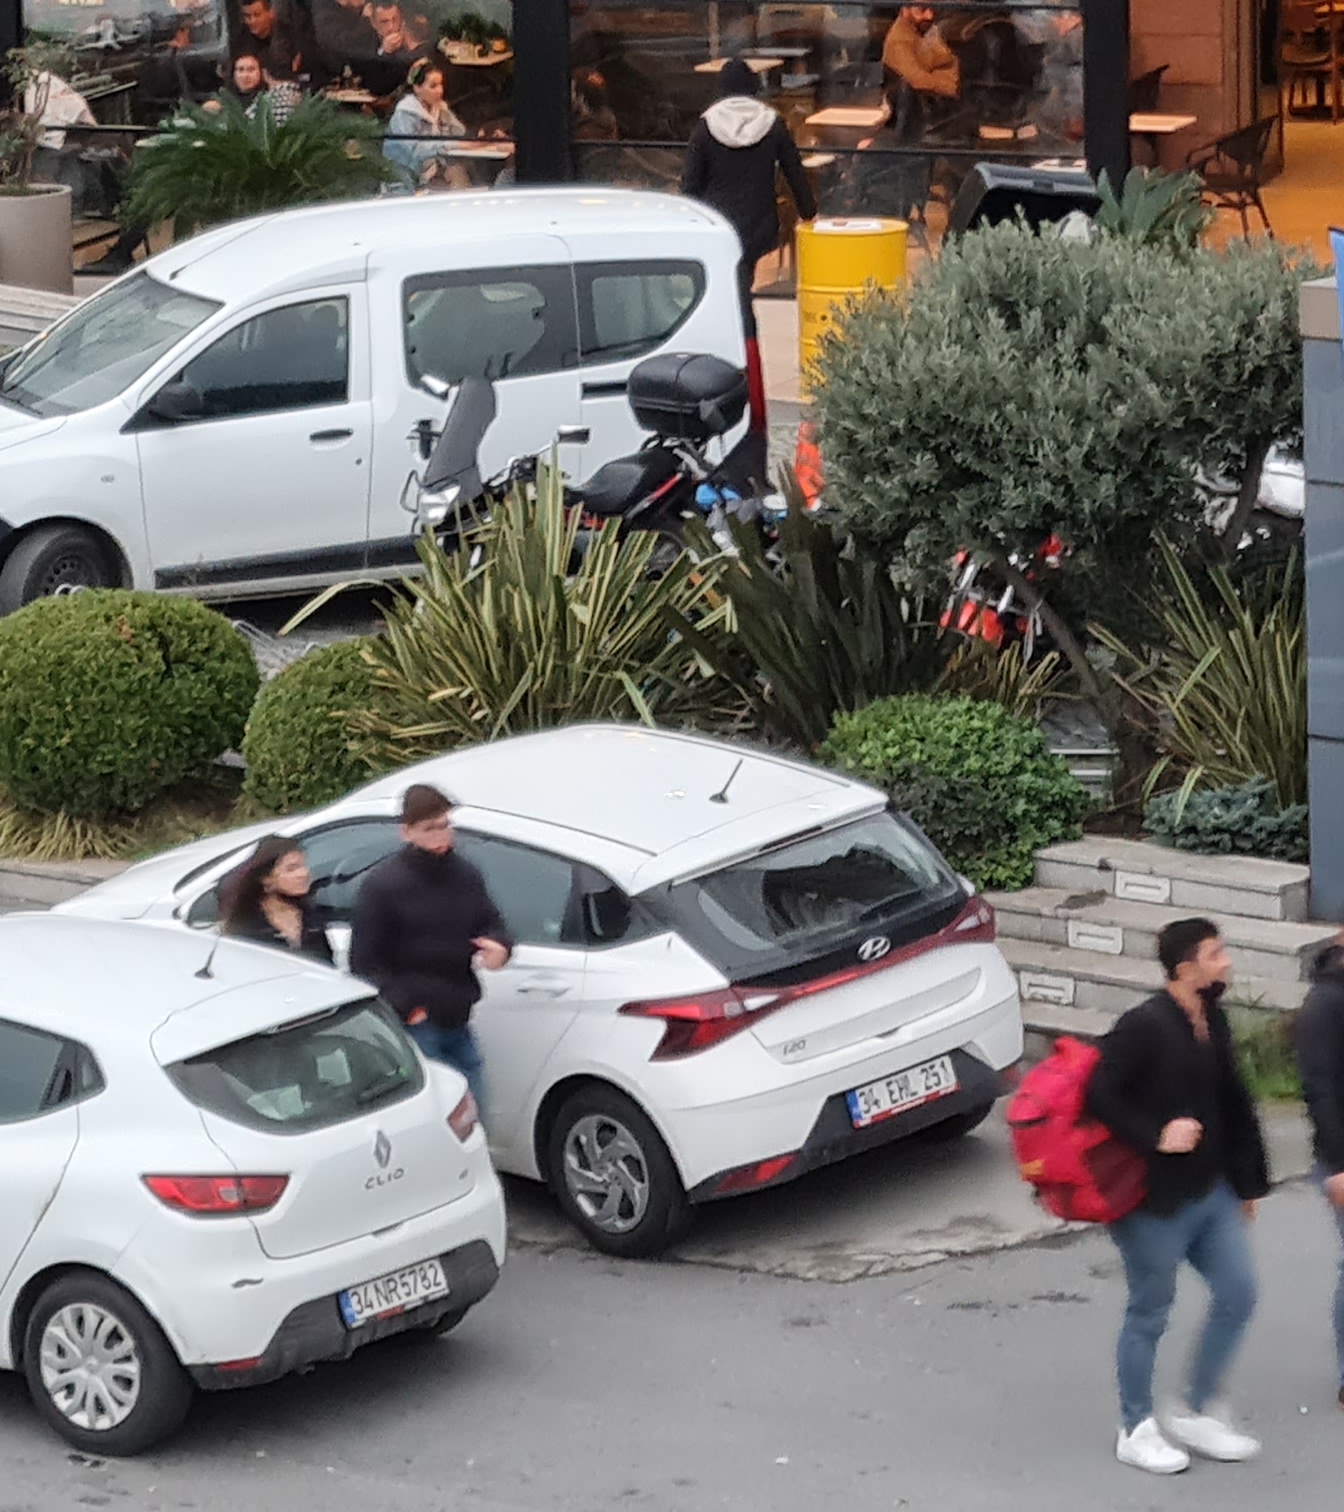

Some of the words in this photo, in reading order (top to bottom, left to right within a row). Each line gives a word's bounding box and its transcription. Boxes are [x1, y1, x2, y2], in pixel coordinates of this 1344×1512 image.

[859, 1088, 882, 1114] 34
[364, 1167, 406, 1190] CLIO
[351, 1280, 375, 1316] 34
